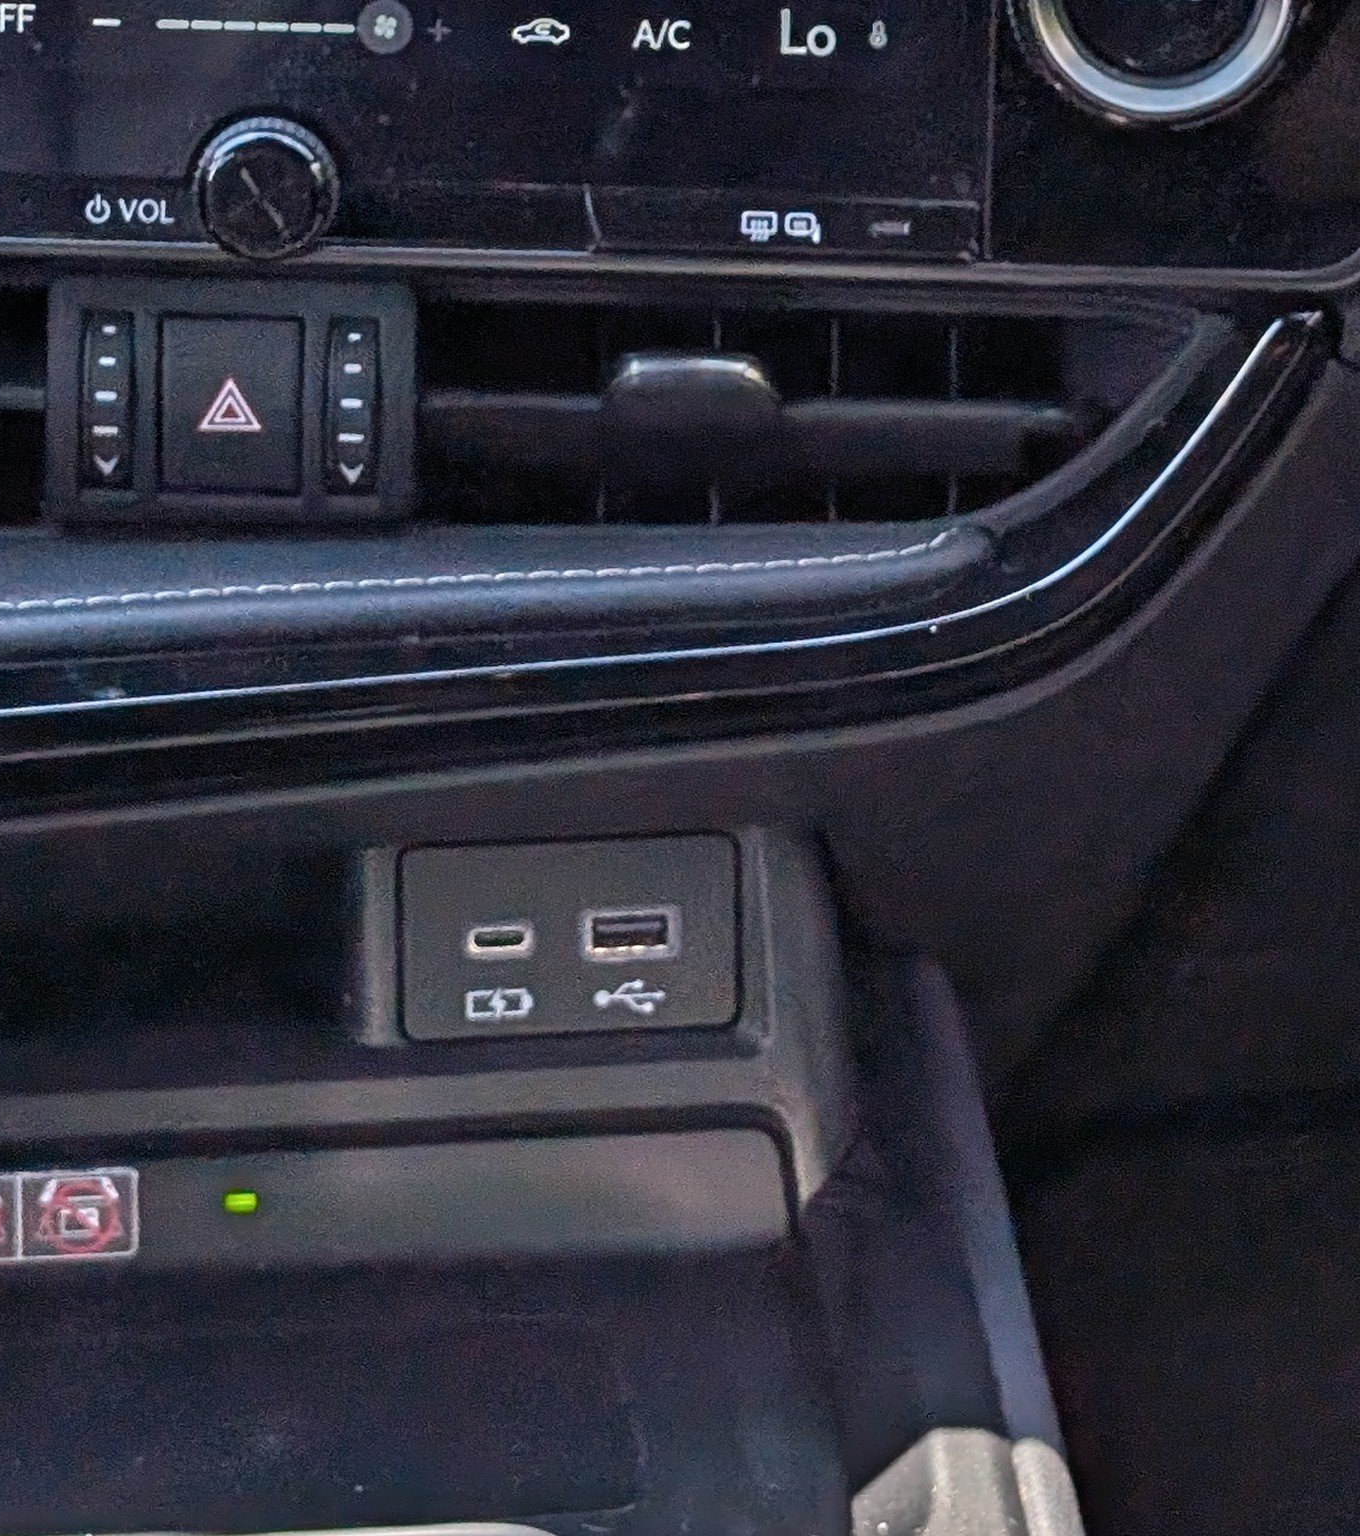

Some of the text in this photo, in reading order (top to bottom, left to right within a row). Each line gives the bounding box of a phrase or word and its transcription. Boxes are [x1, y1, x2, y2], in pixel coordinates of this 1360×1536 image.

[632, 19, 692, 51] A/C
[780, 8, 837, 56] Lo
[119, 199, 175, 224] VOL
